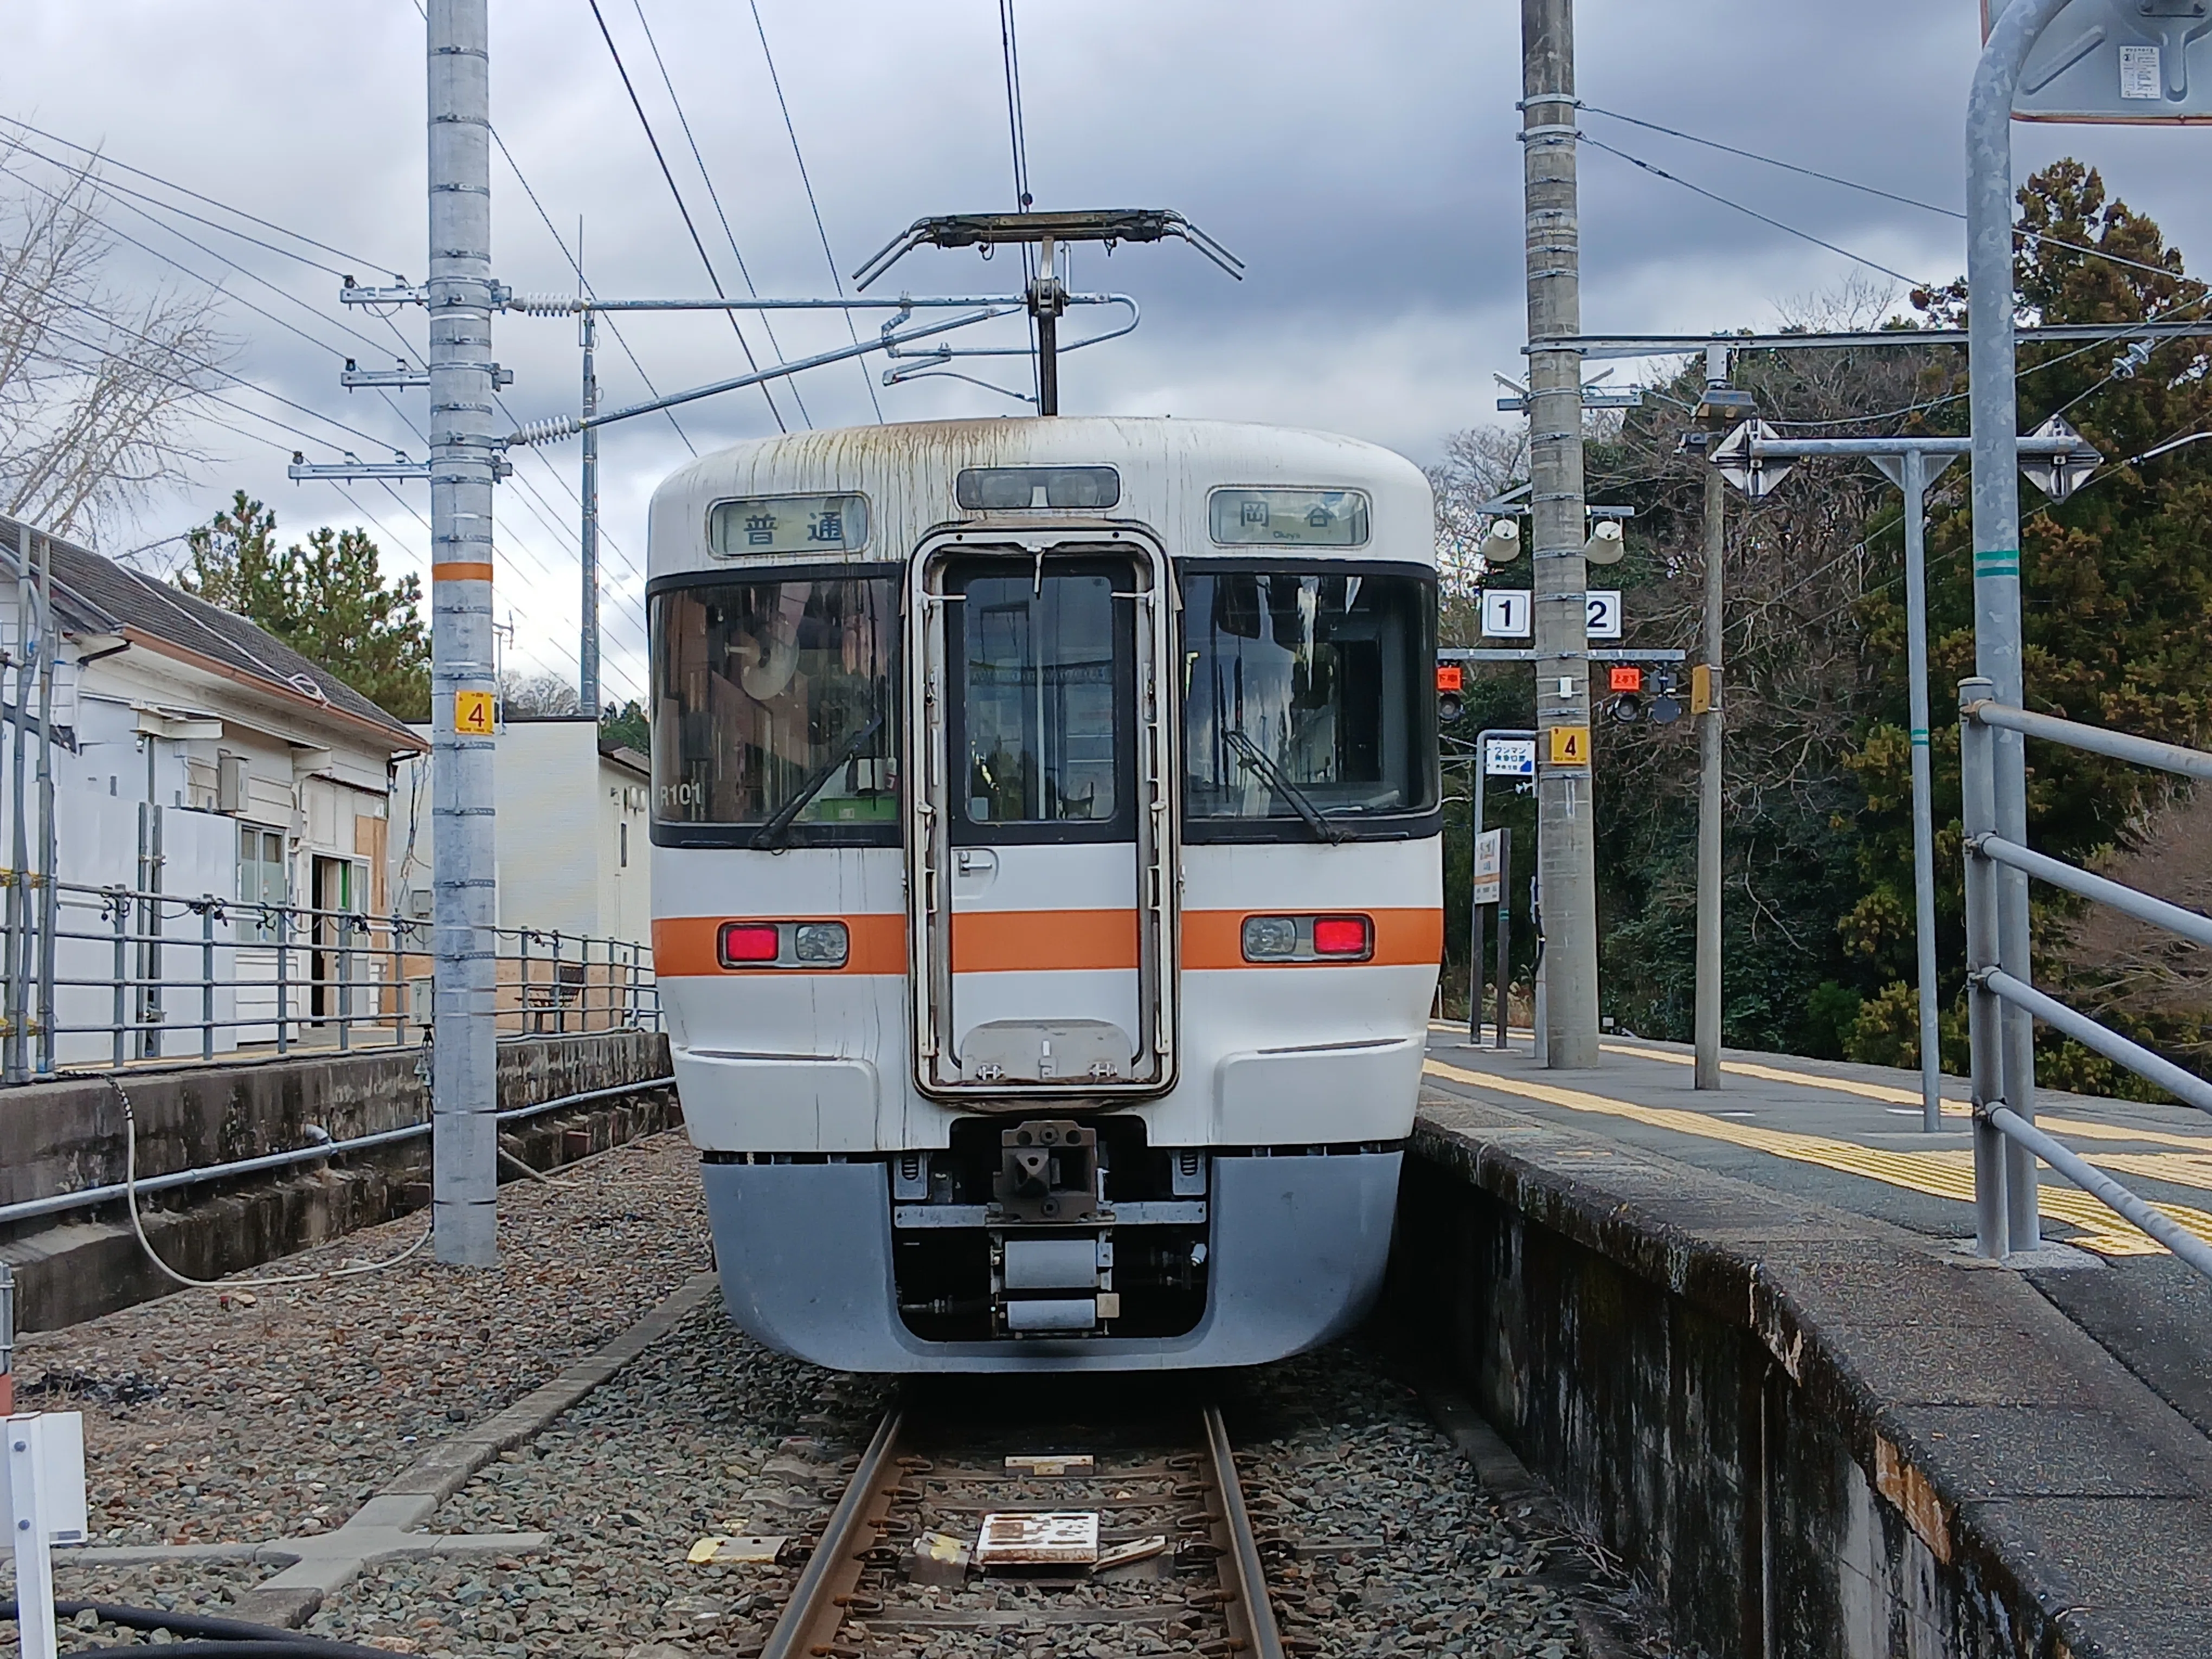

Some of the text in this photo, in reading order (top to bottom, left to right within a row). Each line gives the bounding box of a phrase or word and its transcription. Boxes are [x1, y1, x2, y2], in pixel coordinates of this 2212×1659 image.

[743, 512, 842, 545] 普通
[1498, 599, 1511, 627] 1
[1587, 600, 1607, 628] 2
[468, 703, 485, 728] 4
[1494, 747, 1527, 755] ワンマン
[1564, 735, 1577, 756] 4
[660, 782, 701, 807] R101
